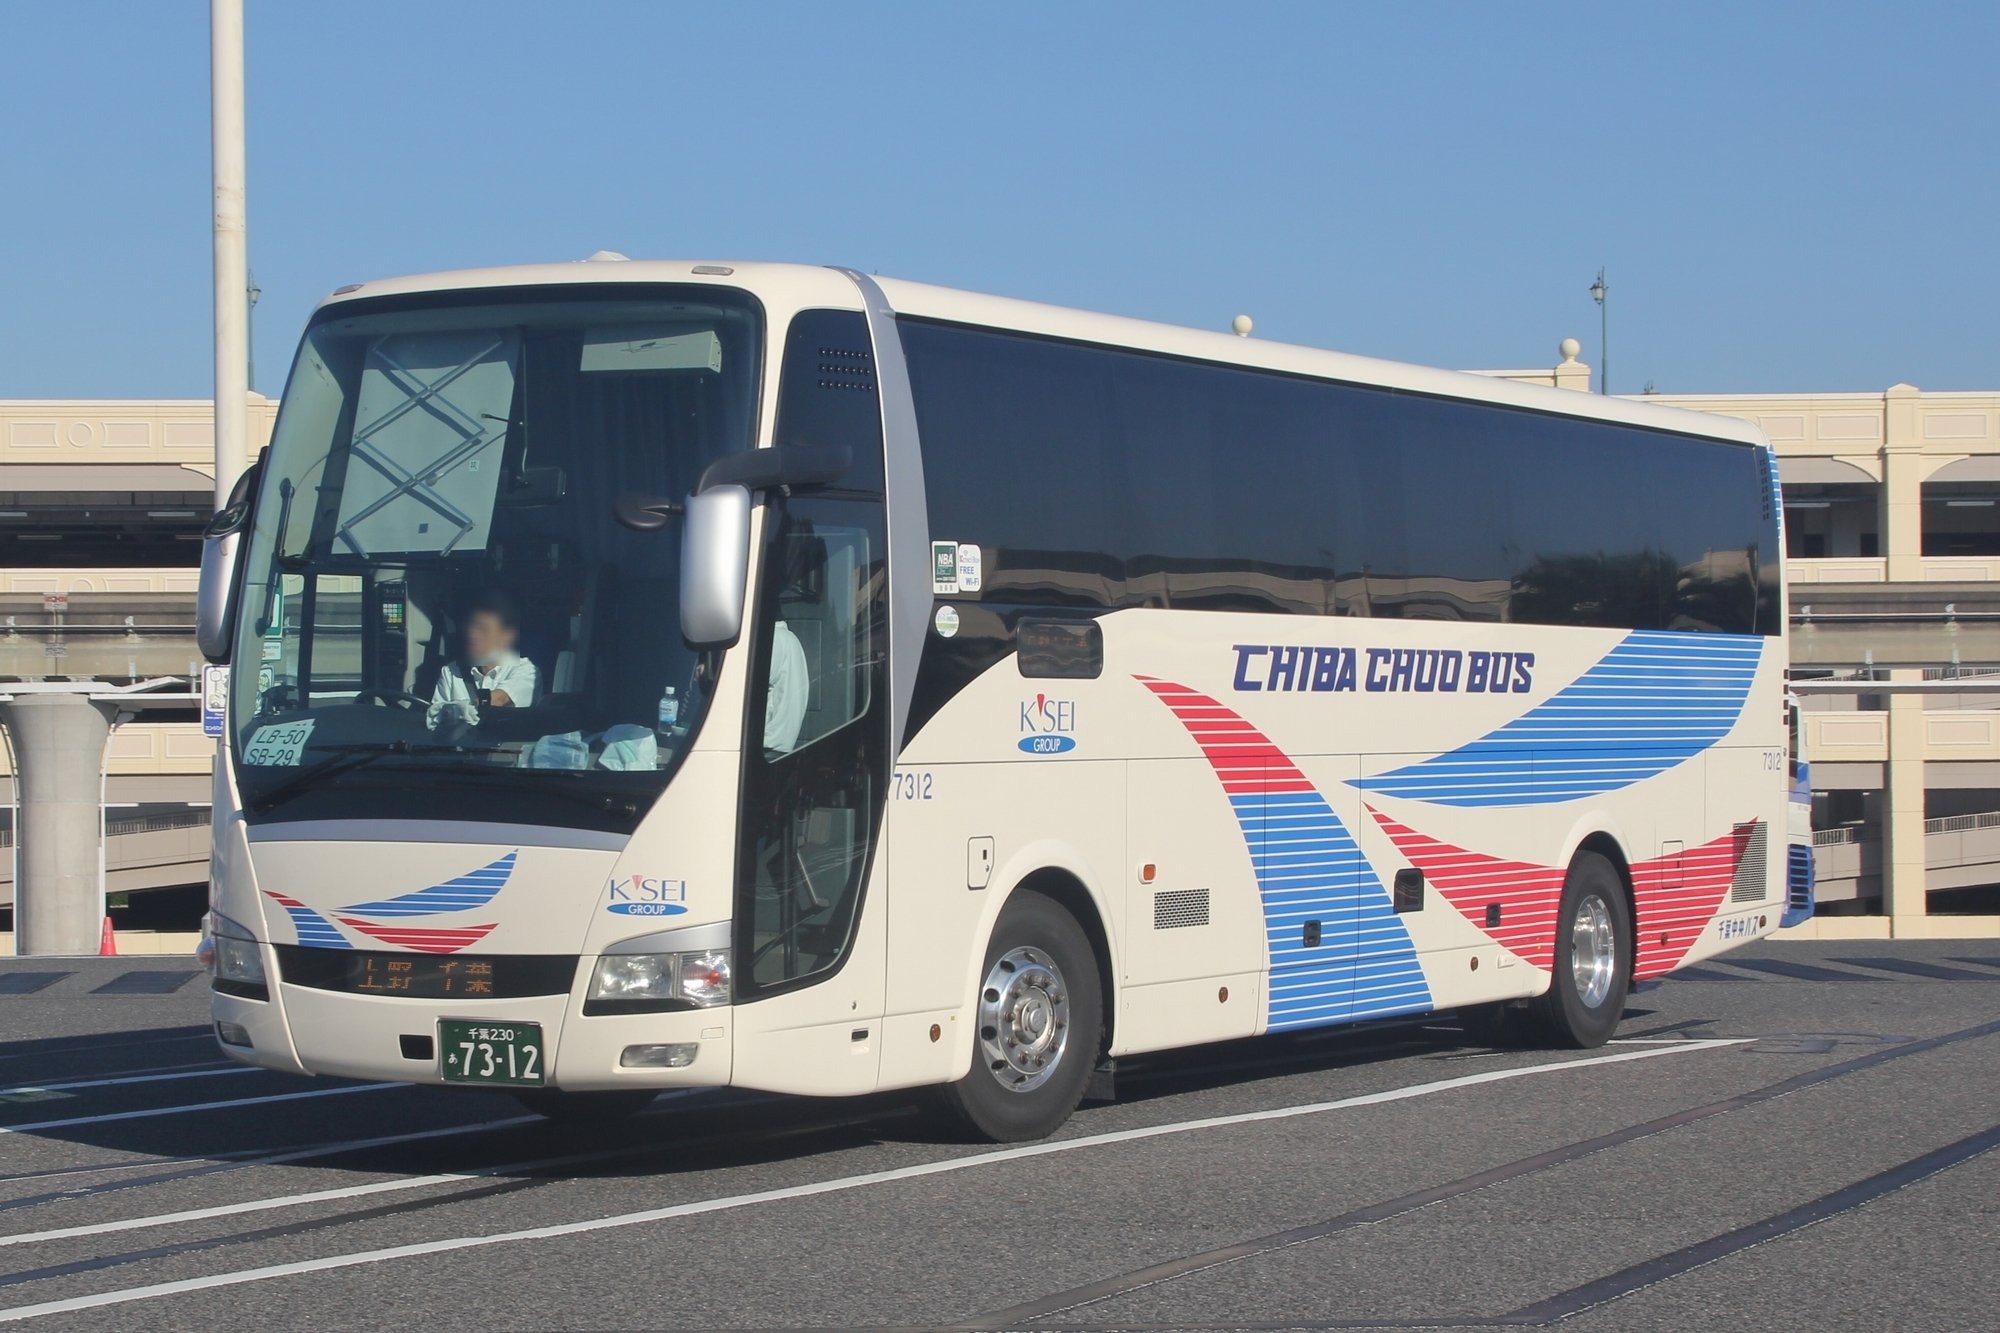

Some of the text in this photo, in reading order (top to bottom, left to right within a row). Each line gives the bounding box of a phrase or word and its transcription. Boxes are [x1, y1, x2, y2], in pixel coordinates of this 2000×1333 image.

[937, 553, 954, 565] NBA
[960, 566, 974, 575] FREE
[1232, 644, 1535, 693] CHIBA CHUO BUS
[256, 729, 306, 745] LB-50
[1033, 738, 1061, 751] GROUP
[247, 748, 294, 766] SB-29
[1763, 752, 1780, 770] 7312
[894, 772, 932, 799] 7312
[628, 904, 666, 915] GROUP
[448, 1053, 458, 1065] あ
